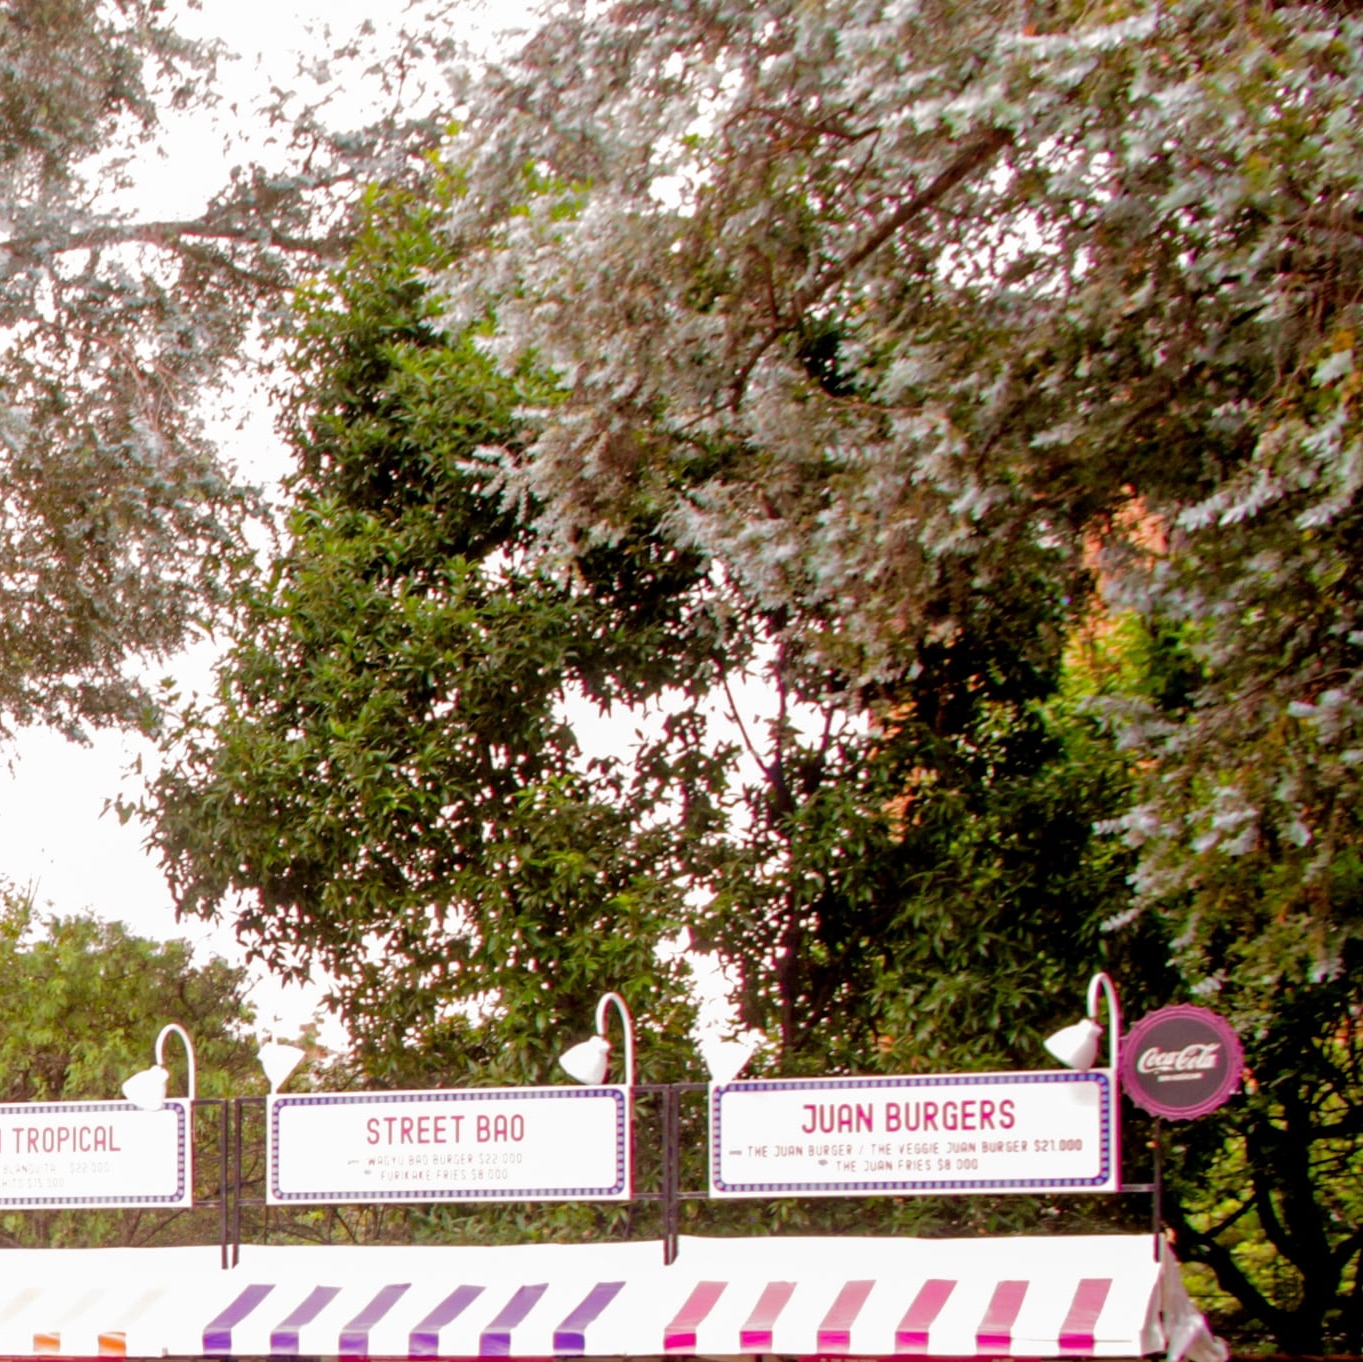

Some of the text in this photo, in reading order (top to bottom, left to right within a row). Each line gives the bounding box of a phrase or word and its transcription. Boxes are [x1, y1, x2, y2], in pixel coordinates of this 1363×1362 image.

[802, 1099, 1016, 1134] JUAN BURGERS
[366, 1113, 524, 1145] STREET BAO
[12, 1125, 121, 1154] TROPICAL
[748, 1145, 768, 1158] THE
[774, 1144, 803, 1157] JUAN
[807, 1143, 852, 1157] BURGER
[871, 1143, 892, 1155] THE
[898, 1142, 939, 1155] VEGGIE
[946, 1141, 976, 1154] JUAN
[981, 1139, 1028, 1153] BURGER
[432, 1153, 474, 1166] BURGER
[835, 1160, 856, 1172] THE
[862, 1159, 893, 1172] JUAN
[898, 1158, 932, 1171] FRIES
[437, 1168, 466, 1181] FRIES
